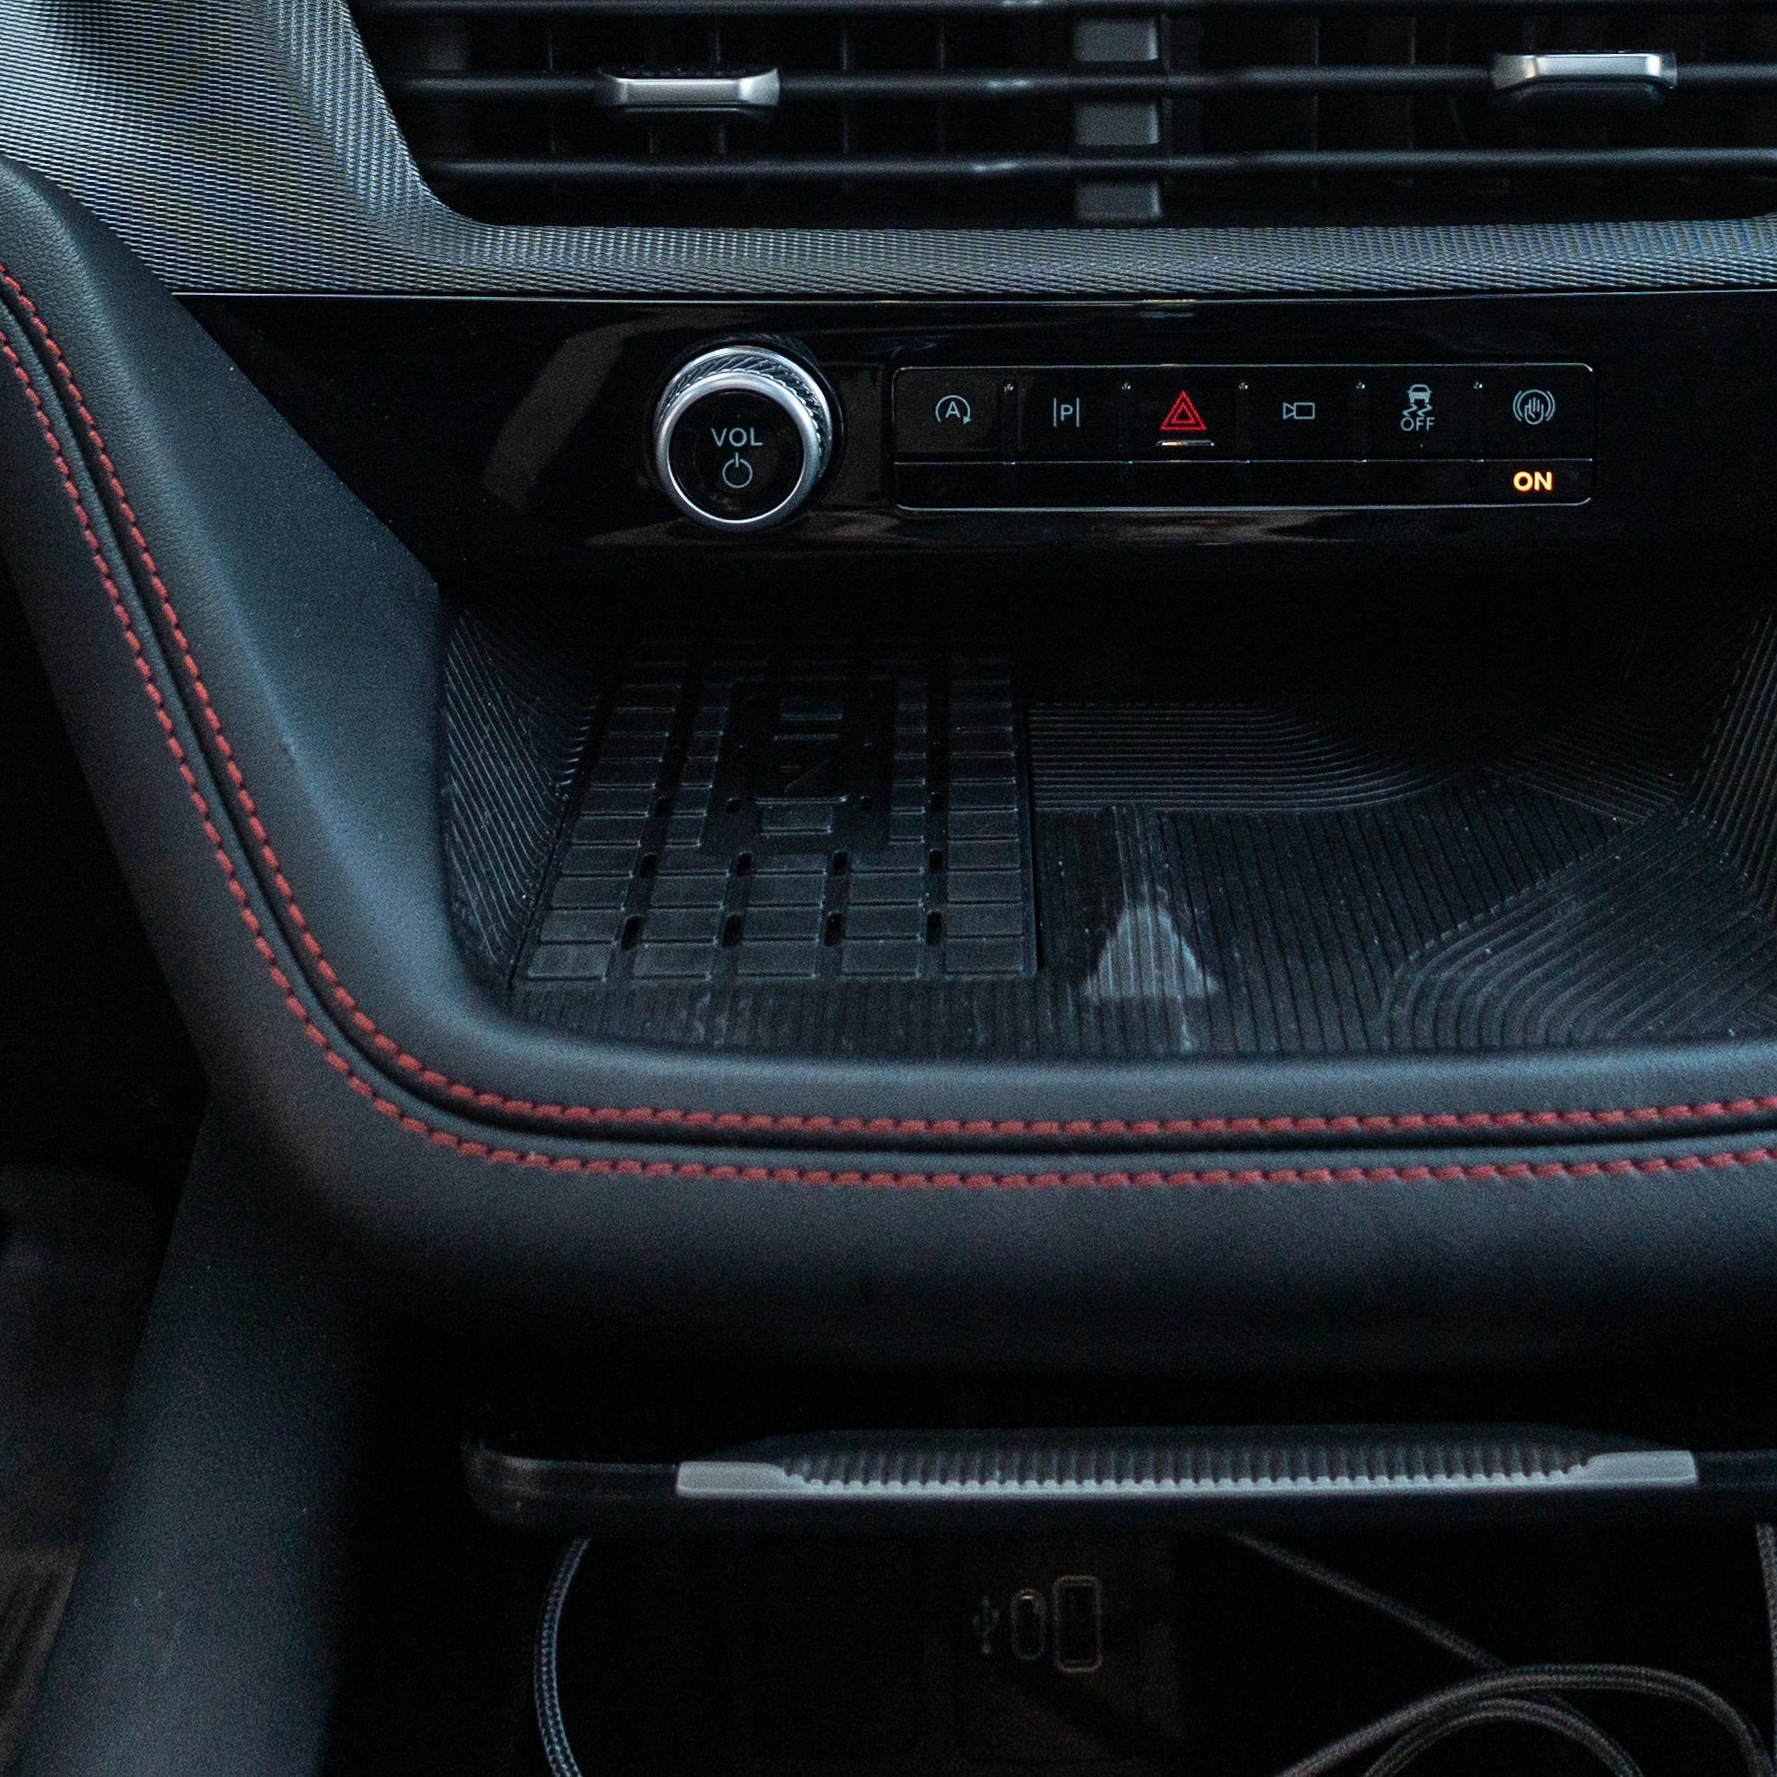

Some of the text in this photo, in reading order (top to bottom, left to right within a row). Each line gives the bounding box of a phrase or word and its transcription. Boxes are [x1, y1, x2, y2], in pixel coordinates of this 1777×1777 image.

[1400, 416, 1436, 431] OFF
[710, 427, 764, 447] VOL
[1512, 470, 1554, 492] ON
